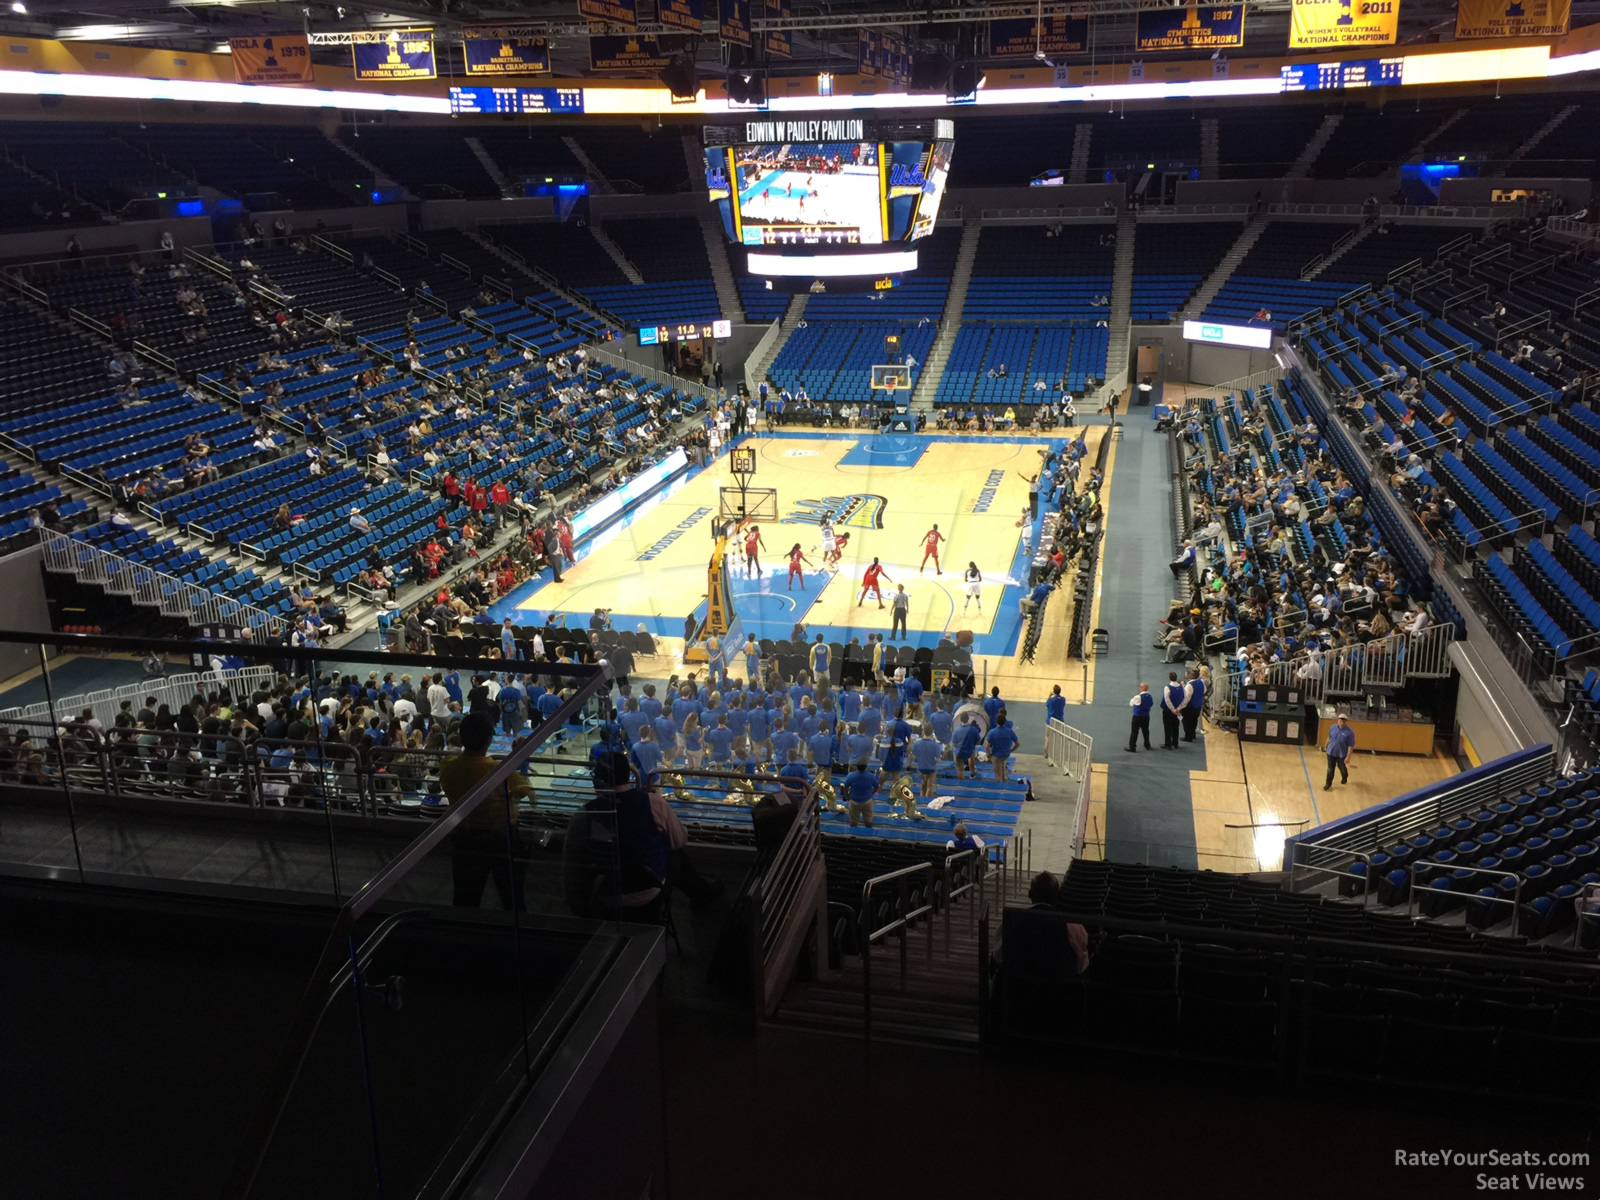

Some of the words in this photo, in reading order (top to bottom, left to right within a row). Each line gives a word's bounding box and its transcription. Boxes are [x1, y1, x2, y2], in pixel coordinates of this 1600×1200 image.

[1361, 2, 1392, 14] 2011
[1213, 10, 1233, 20] 1987
[1167, 28, 1212, 37] GYMNASTICS
[1460, 28, 1506, 36] NATIONAL
[1509, 25, 1563, 34] CHAMPIONS
[232, 39, 259, 49] UCLA
[1141, 37, 1184, 47] NATIONAL
[1187, 35, 1238, 44] CHAMPIONS
[1297, 36, 1339, 44] NATIONAL
[1341, 33, 1390, 42] CHAMPIONS
[996, 45, 1034, 53] NATIONAL
[746, 121, 774, 142] EDWIN
[775, 121, 785, 142] W
[787, 121, 821, 141] PAULEY
[823, 120, 863, 140] PAVILION
[765, 231, 776, 244] 12
[846, 230, 858, 243] 12
[660, 331, 669, 342] 12
[677, 324, 695, 335] 11.0
[703, 327, 712, 338] 12
[635, 530, 686, 561] WOODEN
[676, 507, 713, 528] COURT
